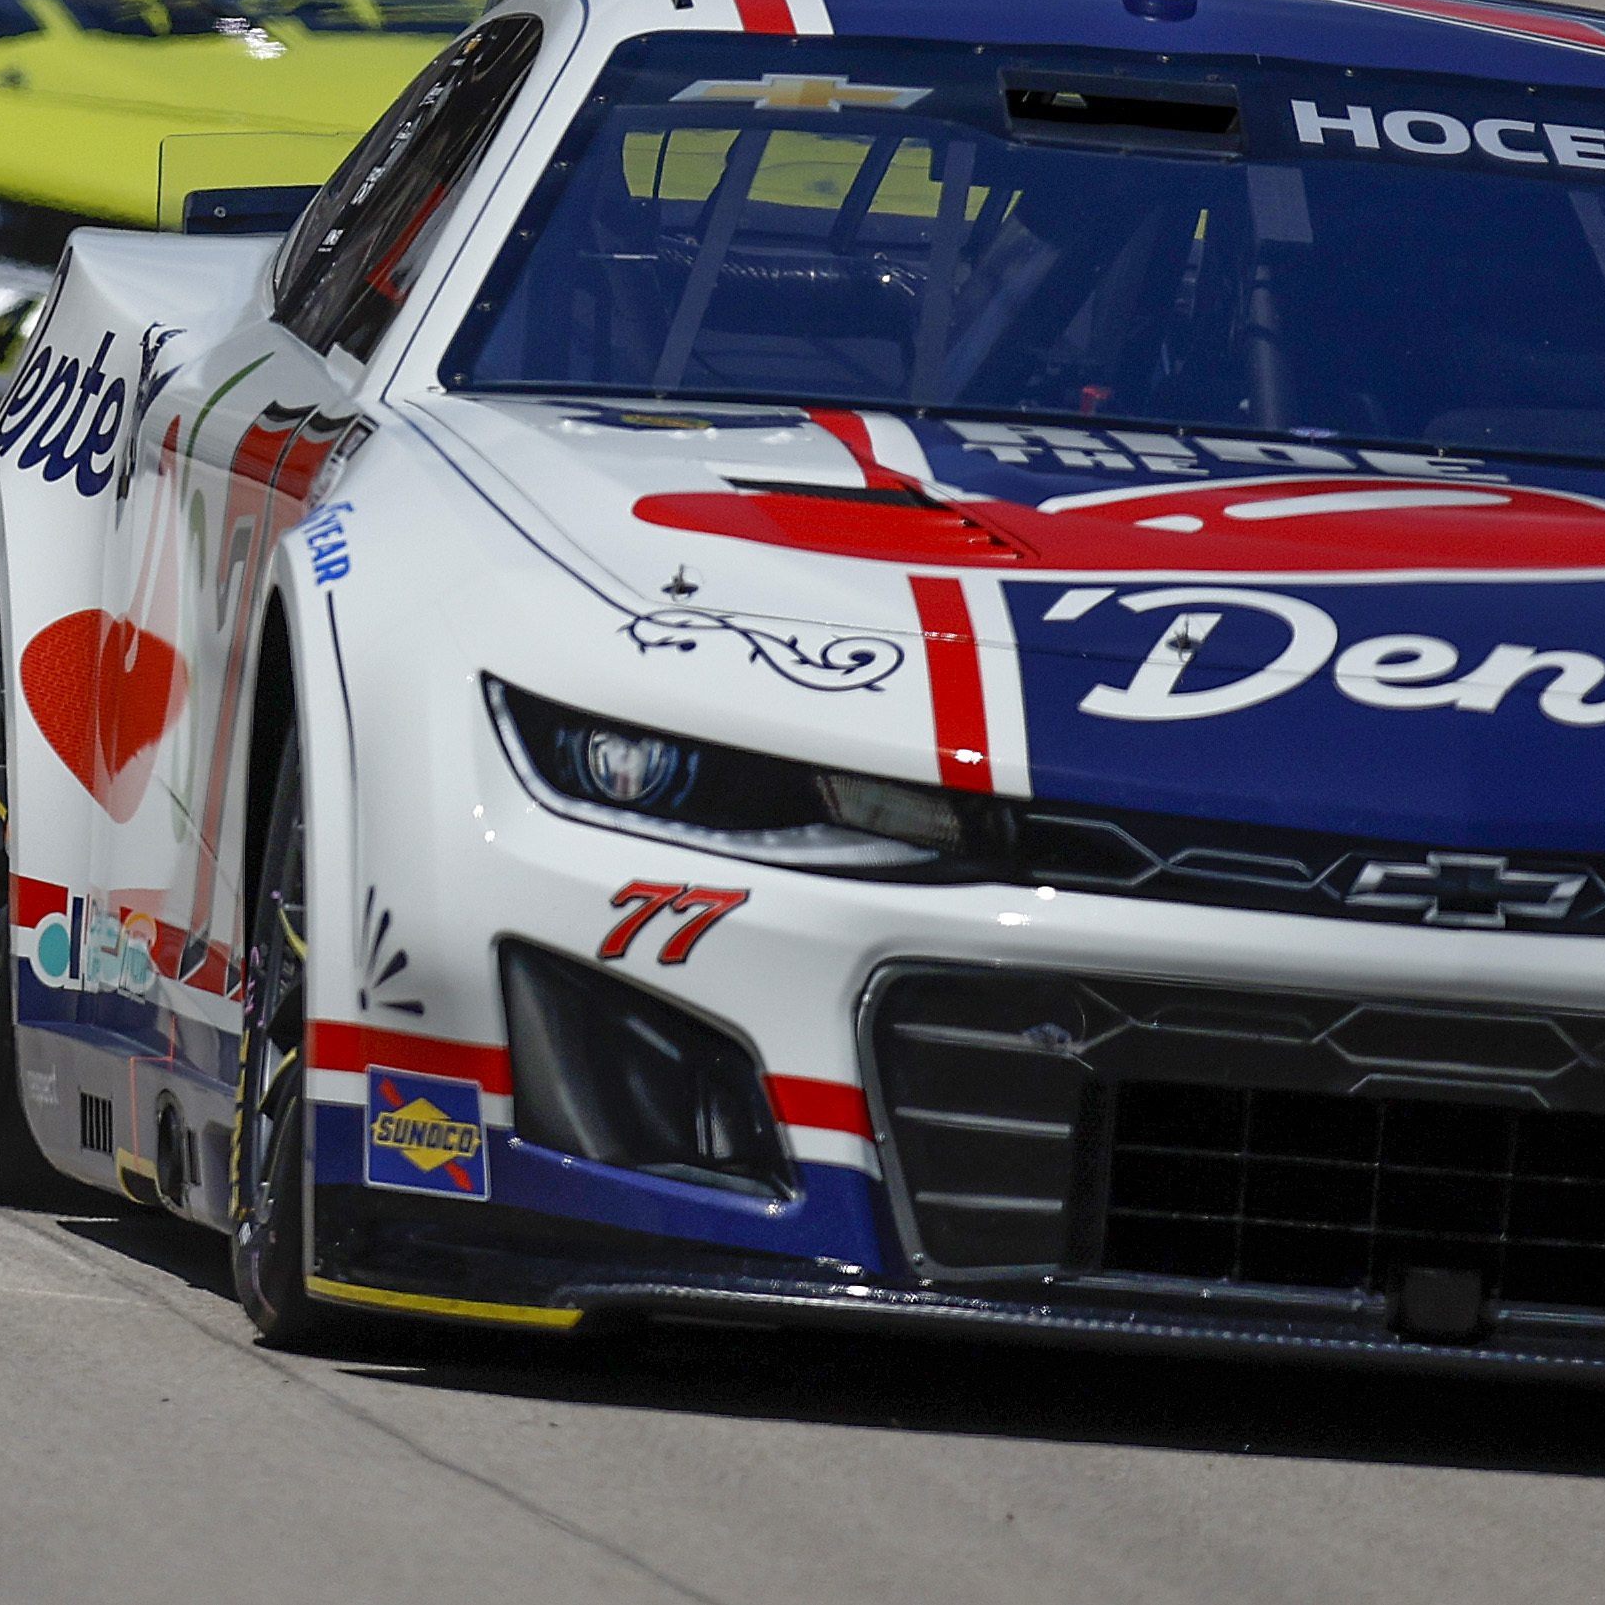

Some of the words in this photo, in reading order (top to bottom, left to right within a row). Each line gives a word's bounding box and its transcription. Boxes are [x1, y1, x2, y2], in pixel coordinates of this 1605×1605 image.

[944, 421, 1509, 483] RIDE
[963, 442, 1210, 476] THE
[296, 501, 354, 586] YEAR
[598, 879, 751, 965] 77
[376, 1114, 476, 1154] SUNOCO
